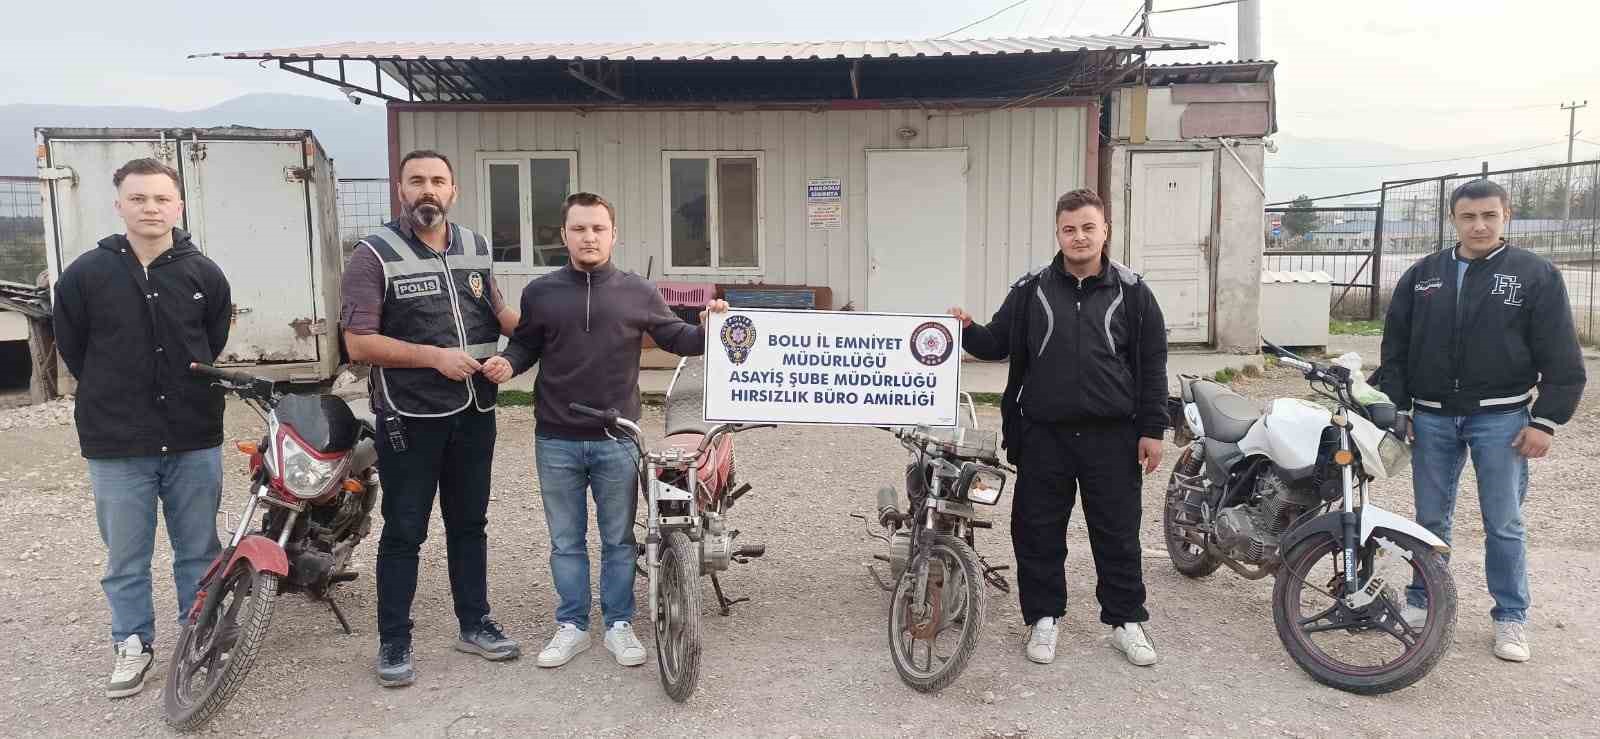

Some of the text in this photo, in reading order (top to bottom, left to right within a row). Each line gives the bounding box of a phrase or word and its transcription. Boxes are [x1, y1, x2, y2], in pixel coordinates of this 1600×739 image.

[768, 332, 903, 350] BOLU İL EMNİYET
[782, 350, 887, 368] MÜDÜRLÜĞÜ
[729, 368, 937, 388] ASAYİŞ ŞUBE MÜDÜRLÜĞÜ
[731, 388, 935, 406] HIRSIZLIK BÜRO AMİRLİĞİ
[1345, 548, 1353, 582] facebook
